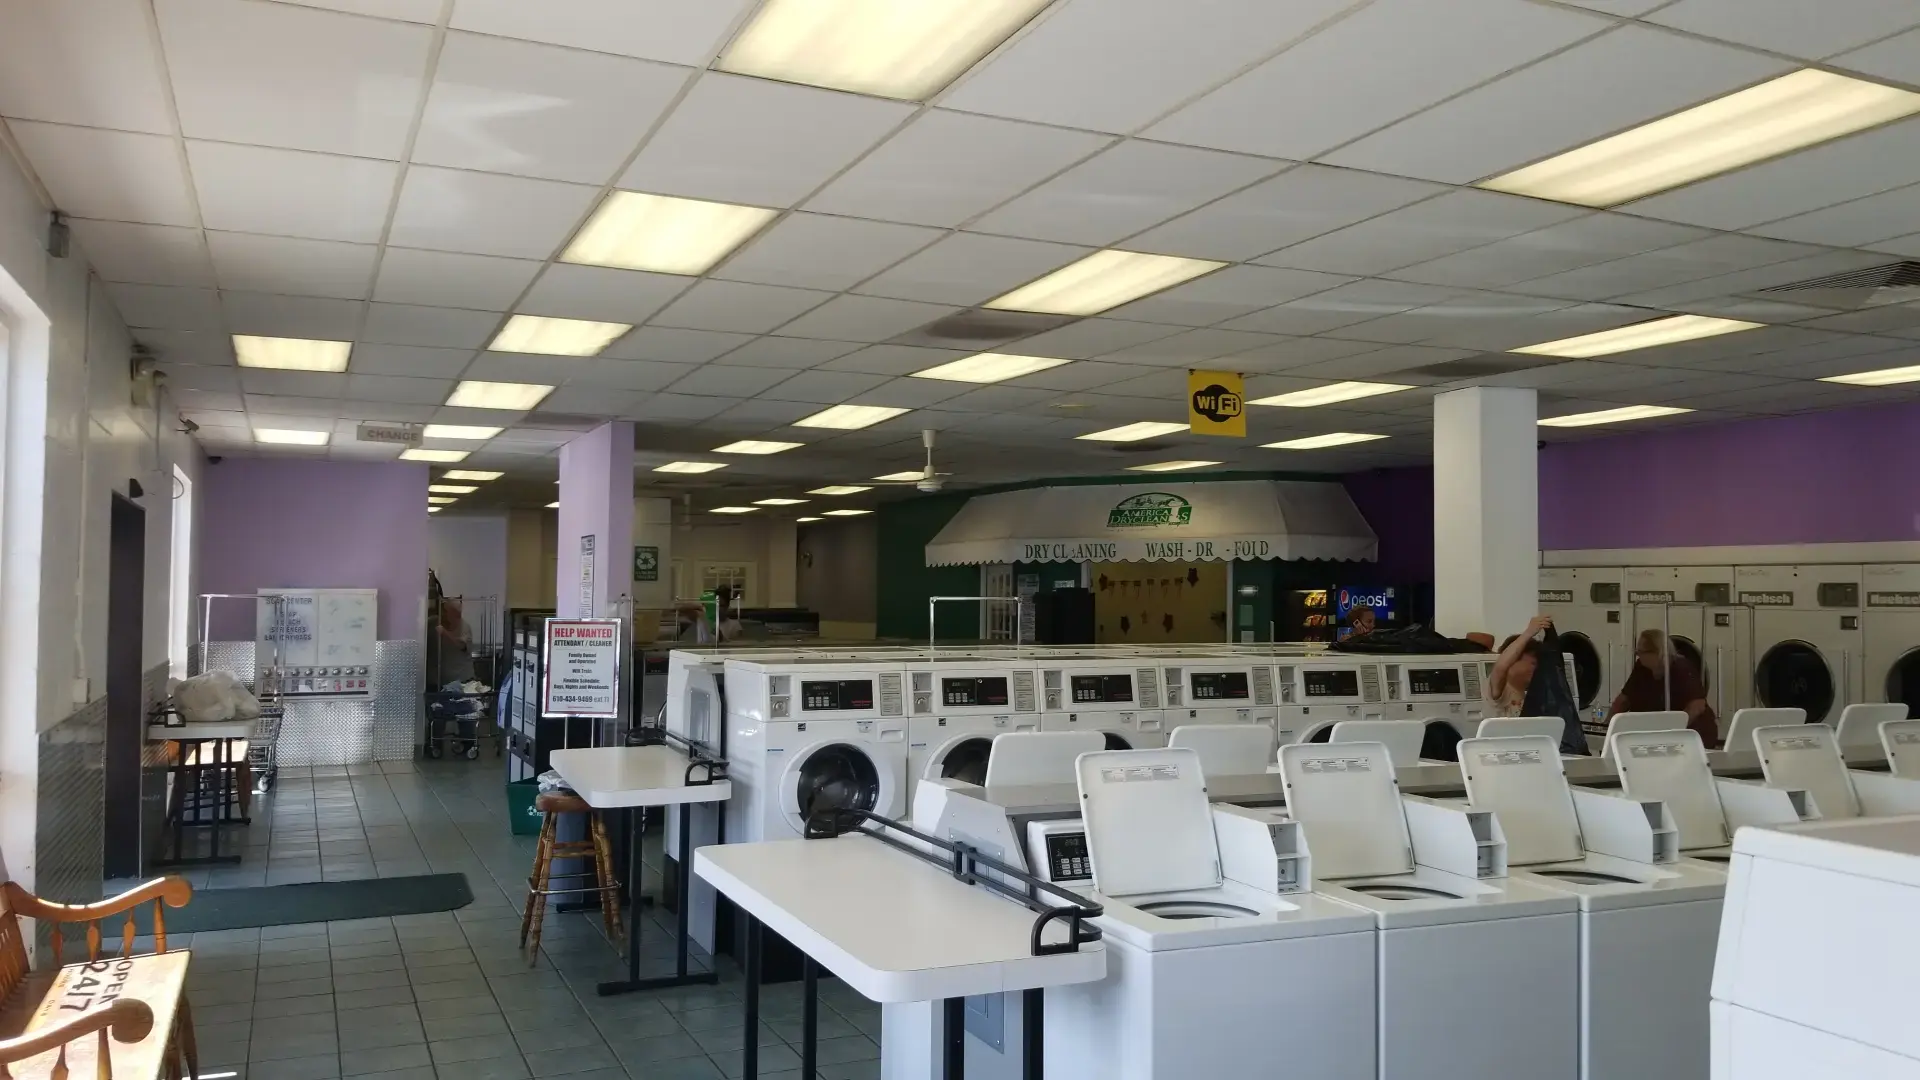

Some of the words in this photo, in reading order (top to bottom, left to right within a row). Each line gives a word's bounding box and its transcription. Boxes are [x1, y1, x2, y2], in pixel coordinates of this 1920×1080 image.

[367, 429, 418, 441] CHANGE
[1025, 544, 1050, 558] DRY
[1146, 542, 1184, 557] WASH
[1351, 592, 1387, 607] pepsi
[1630, 592, 1672, 602] Huebsch
[1741, 593, 1791, 604] Huebsch
[1870, 594, 1920, 605] Huebsc
[554, 628, 575, 638] HELP
[577, 628, 612, 638] WANTED
[97, 960, 133, 1005] OPEN
